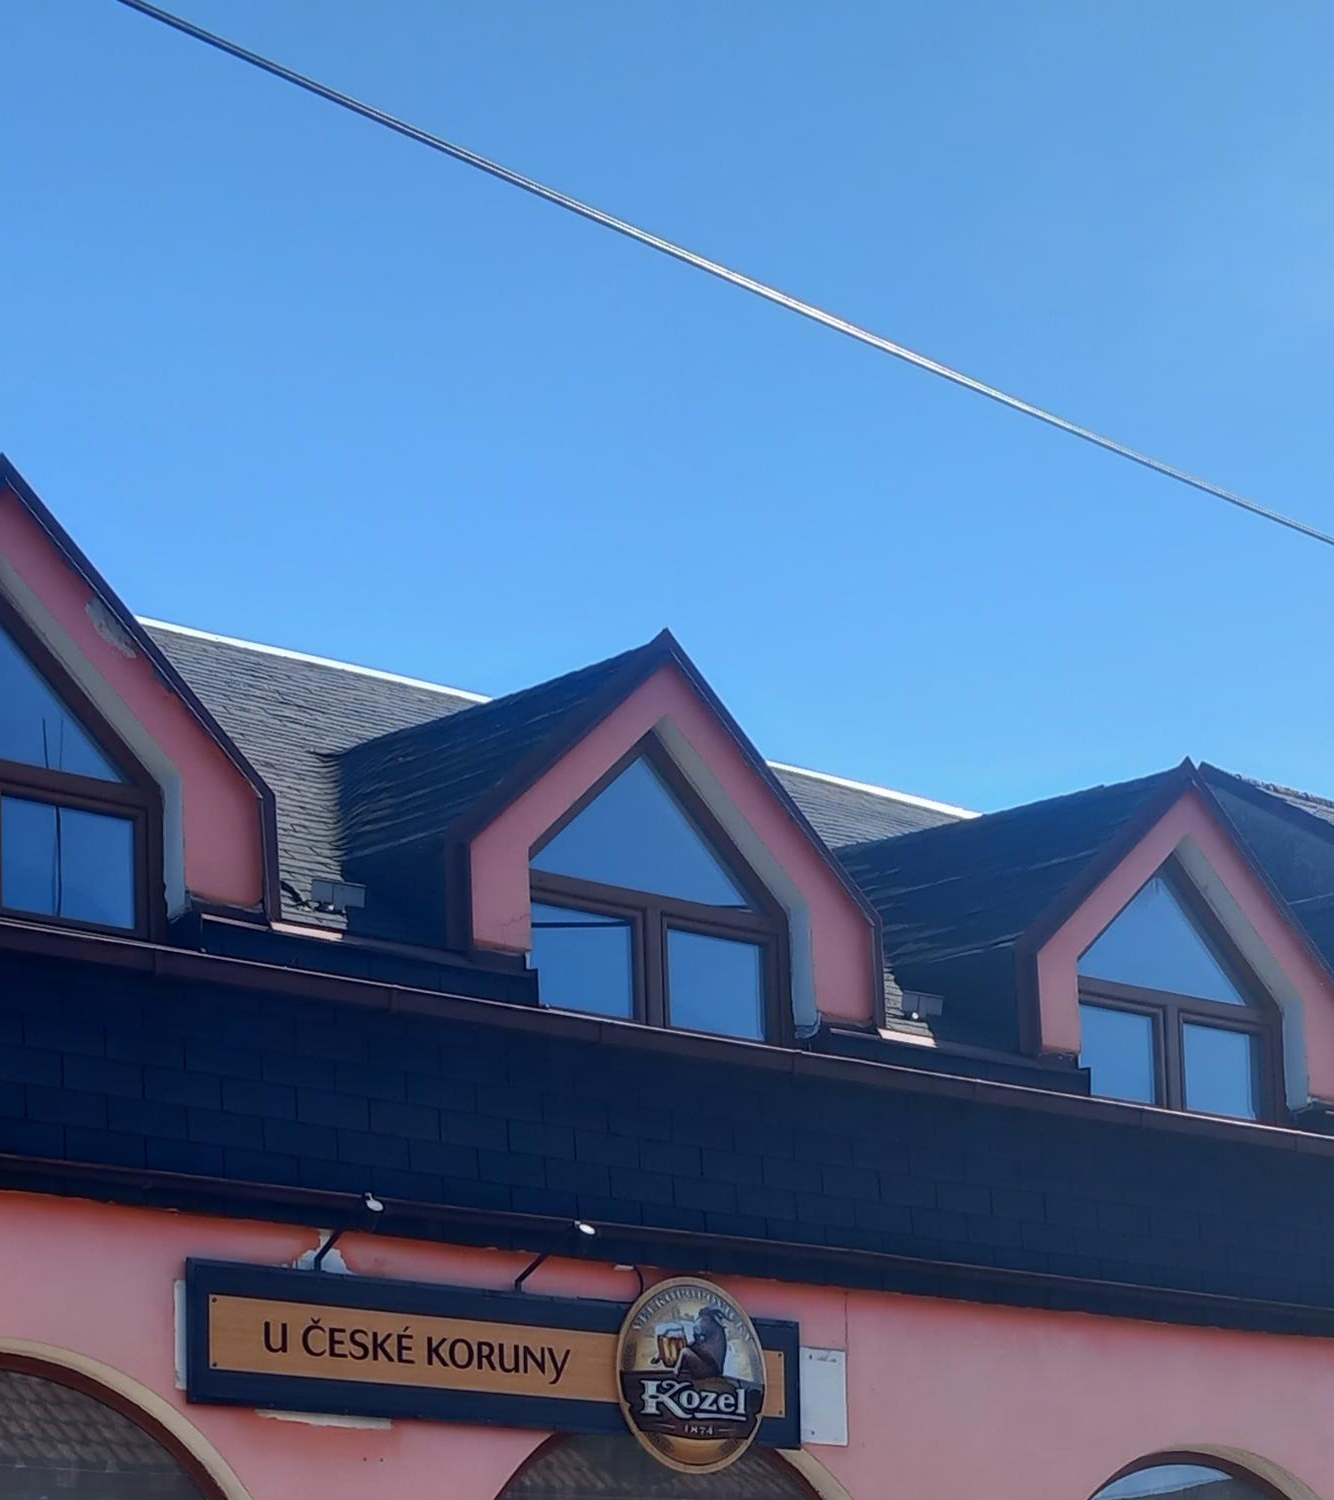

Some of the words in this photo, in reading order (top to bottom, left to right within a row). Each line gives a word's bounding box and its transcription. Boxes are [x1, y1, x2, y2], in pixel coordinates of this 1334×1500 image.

[263, 1320, 288, 1354] U
[301, 1316, 416, 1365] ČESKÉ
[426, 1335, 572, 1385] KORUNY
[640, 1379, 748, 1420] Kozel
[683, 1424, 715, 1436] 1874
